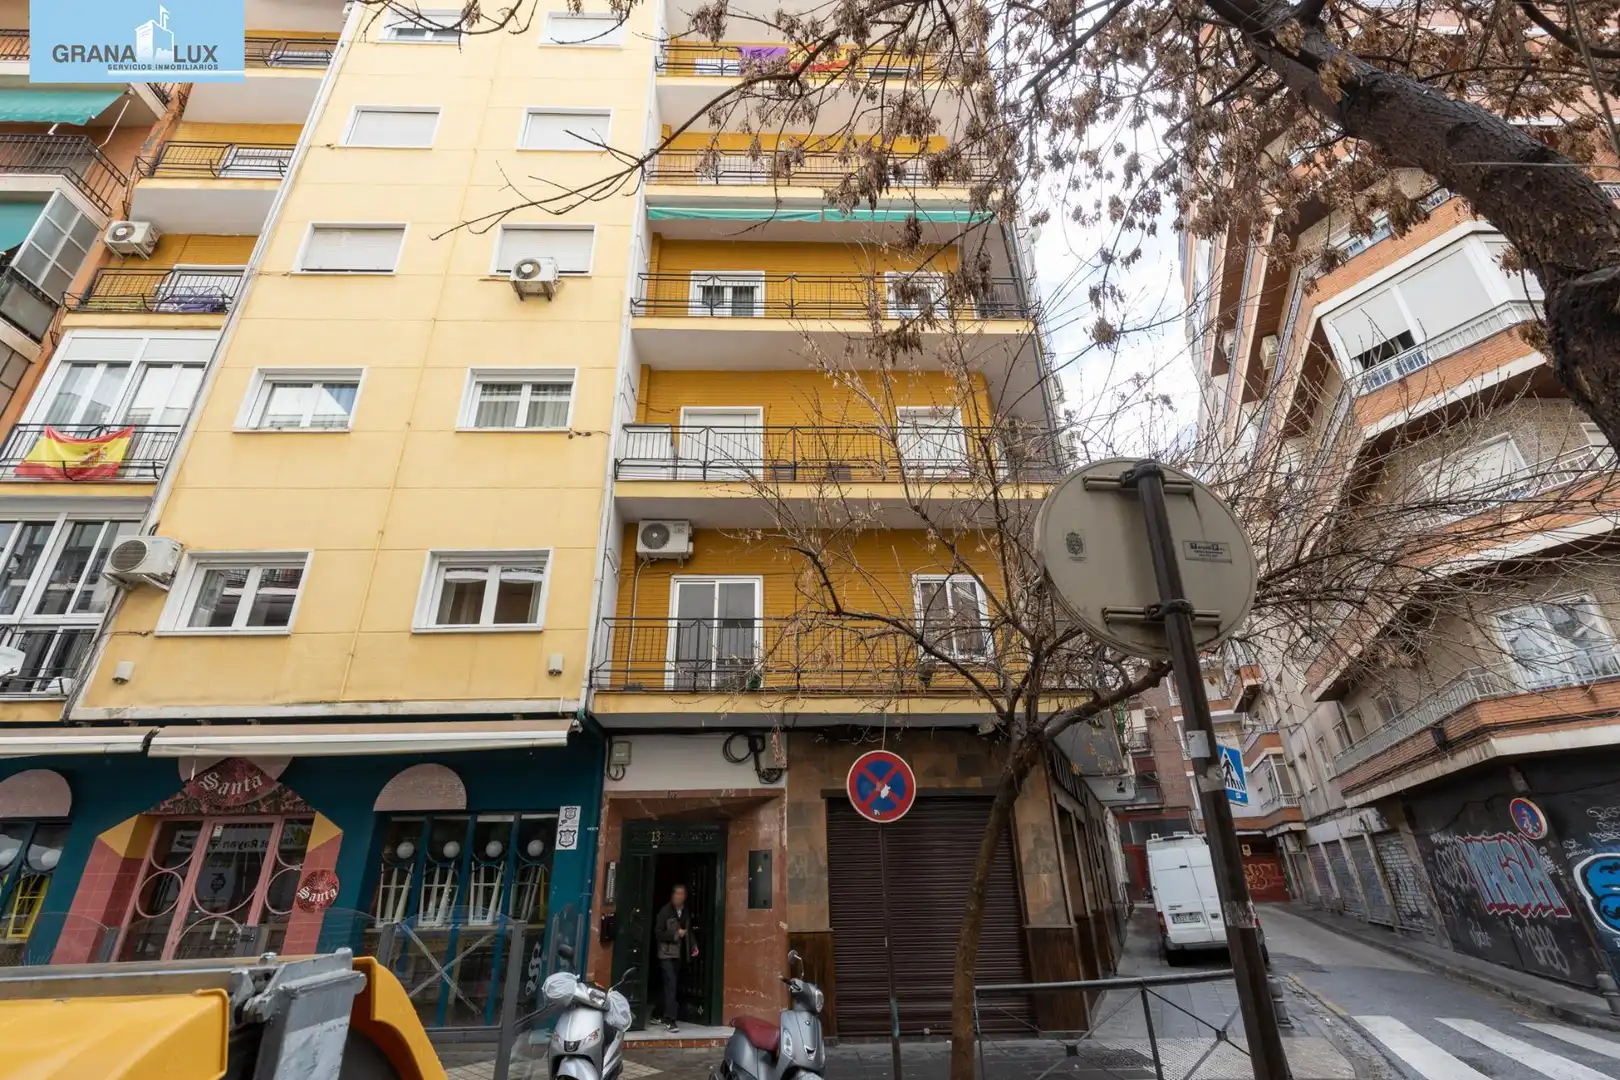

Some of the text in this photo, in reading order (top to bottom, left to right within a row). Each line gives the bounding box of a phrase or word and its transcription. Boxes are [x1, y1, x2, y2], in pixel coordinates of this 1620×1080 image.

[200, 771, 263, 796] Santa
[651, 830, 661, 842] 13
[297, 885, 338, 903] Santa
